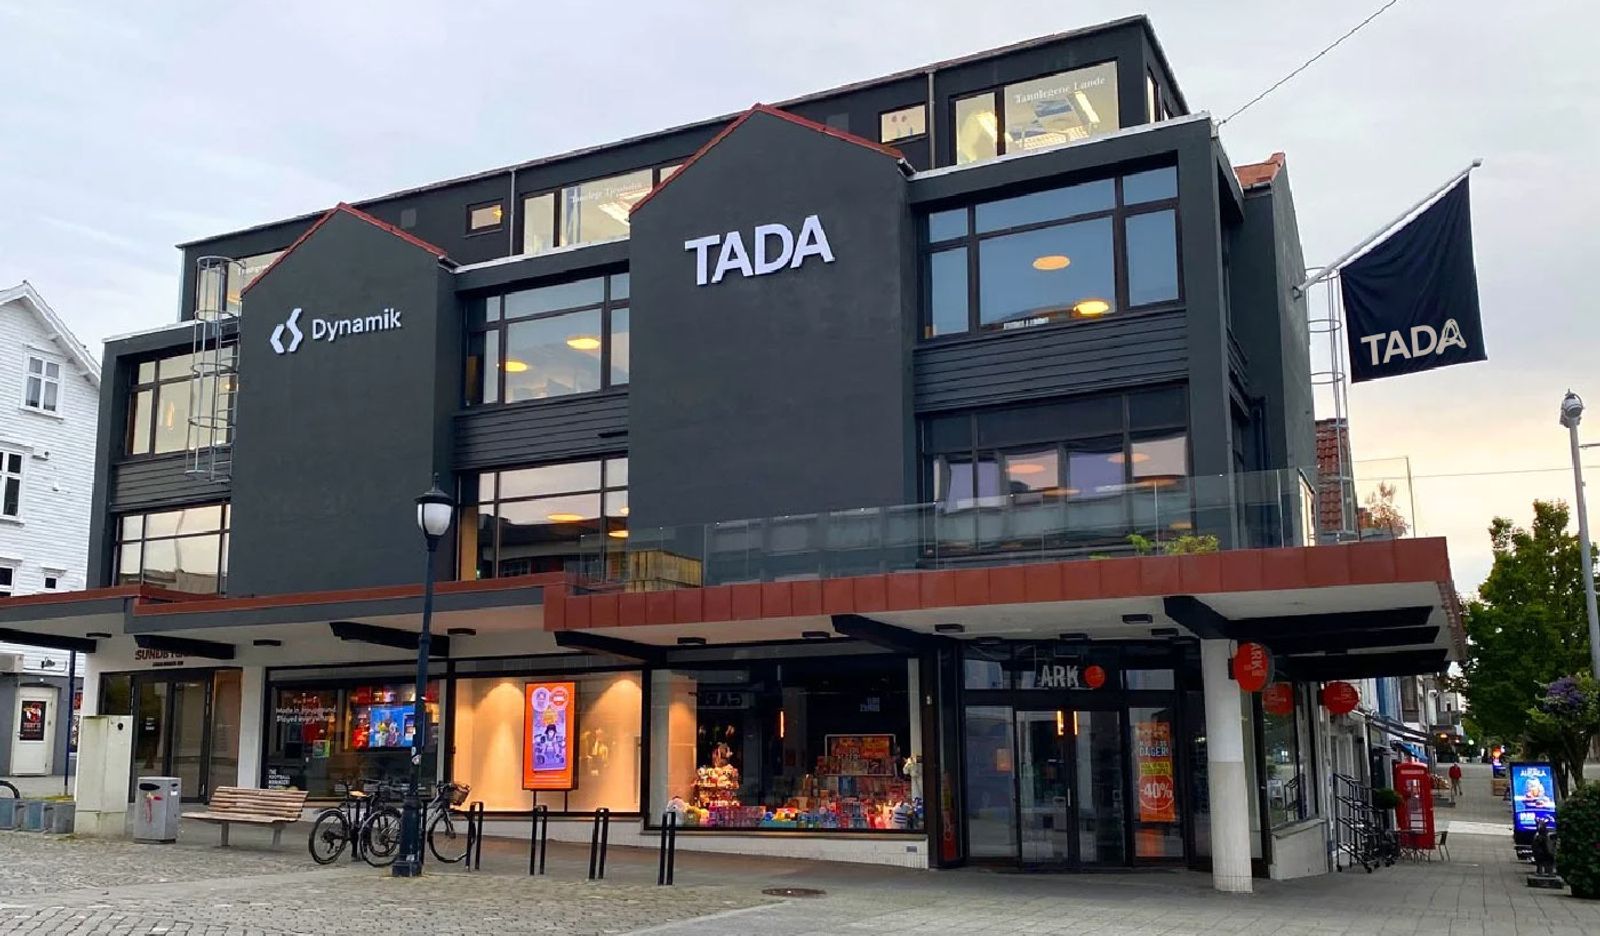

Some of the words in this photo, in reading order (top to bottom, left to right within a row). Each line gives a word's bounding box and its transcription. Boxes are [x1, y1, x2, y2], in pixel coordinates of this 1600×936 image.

[684, 214, 836, 286] TADA
[312, 307, 402, 342] Dynamik
[1360, 318, 1467, 366] TADA
[1041, 665, 1079, 689] ARK
[1140, 782, 1174, 799] -40%
